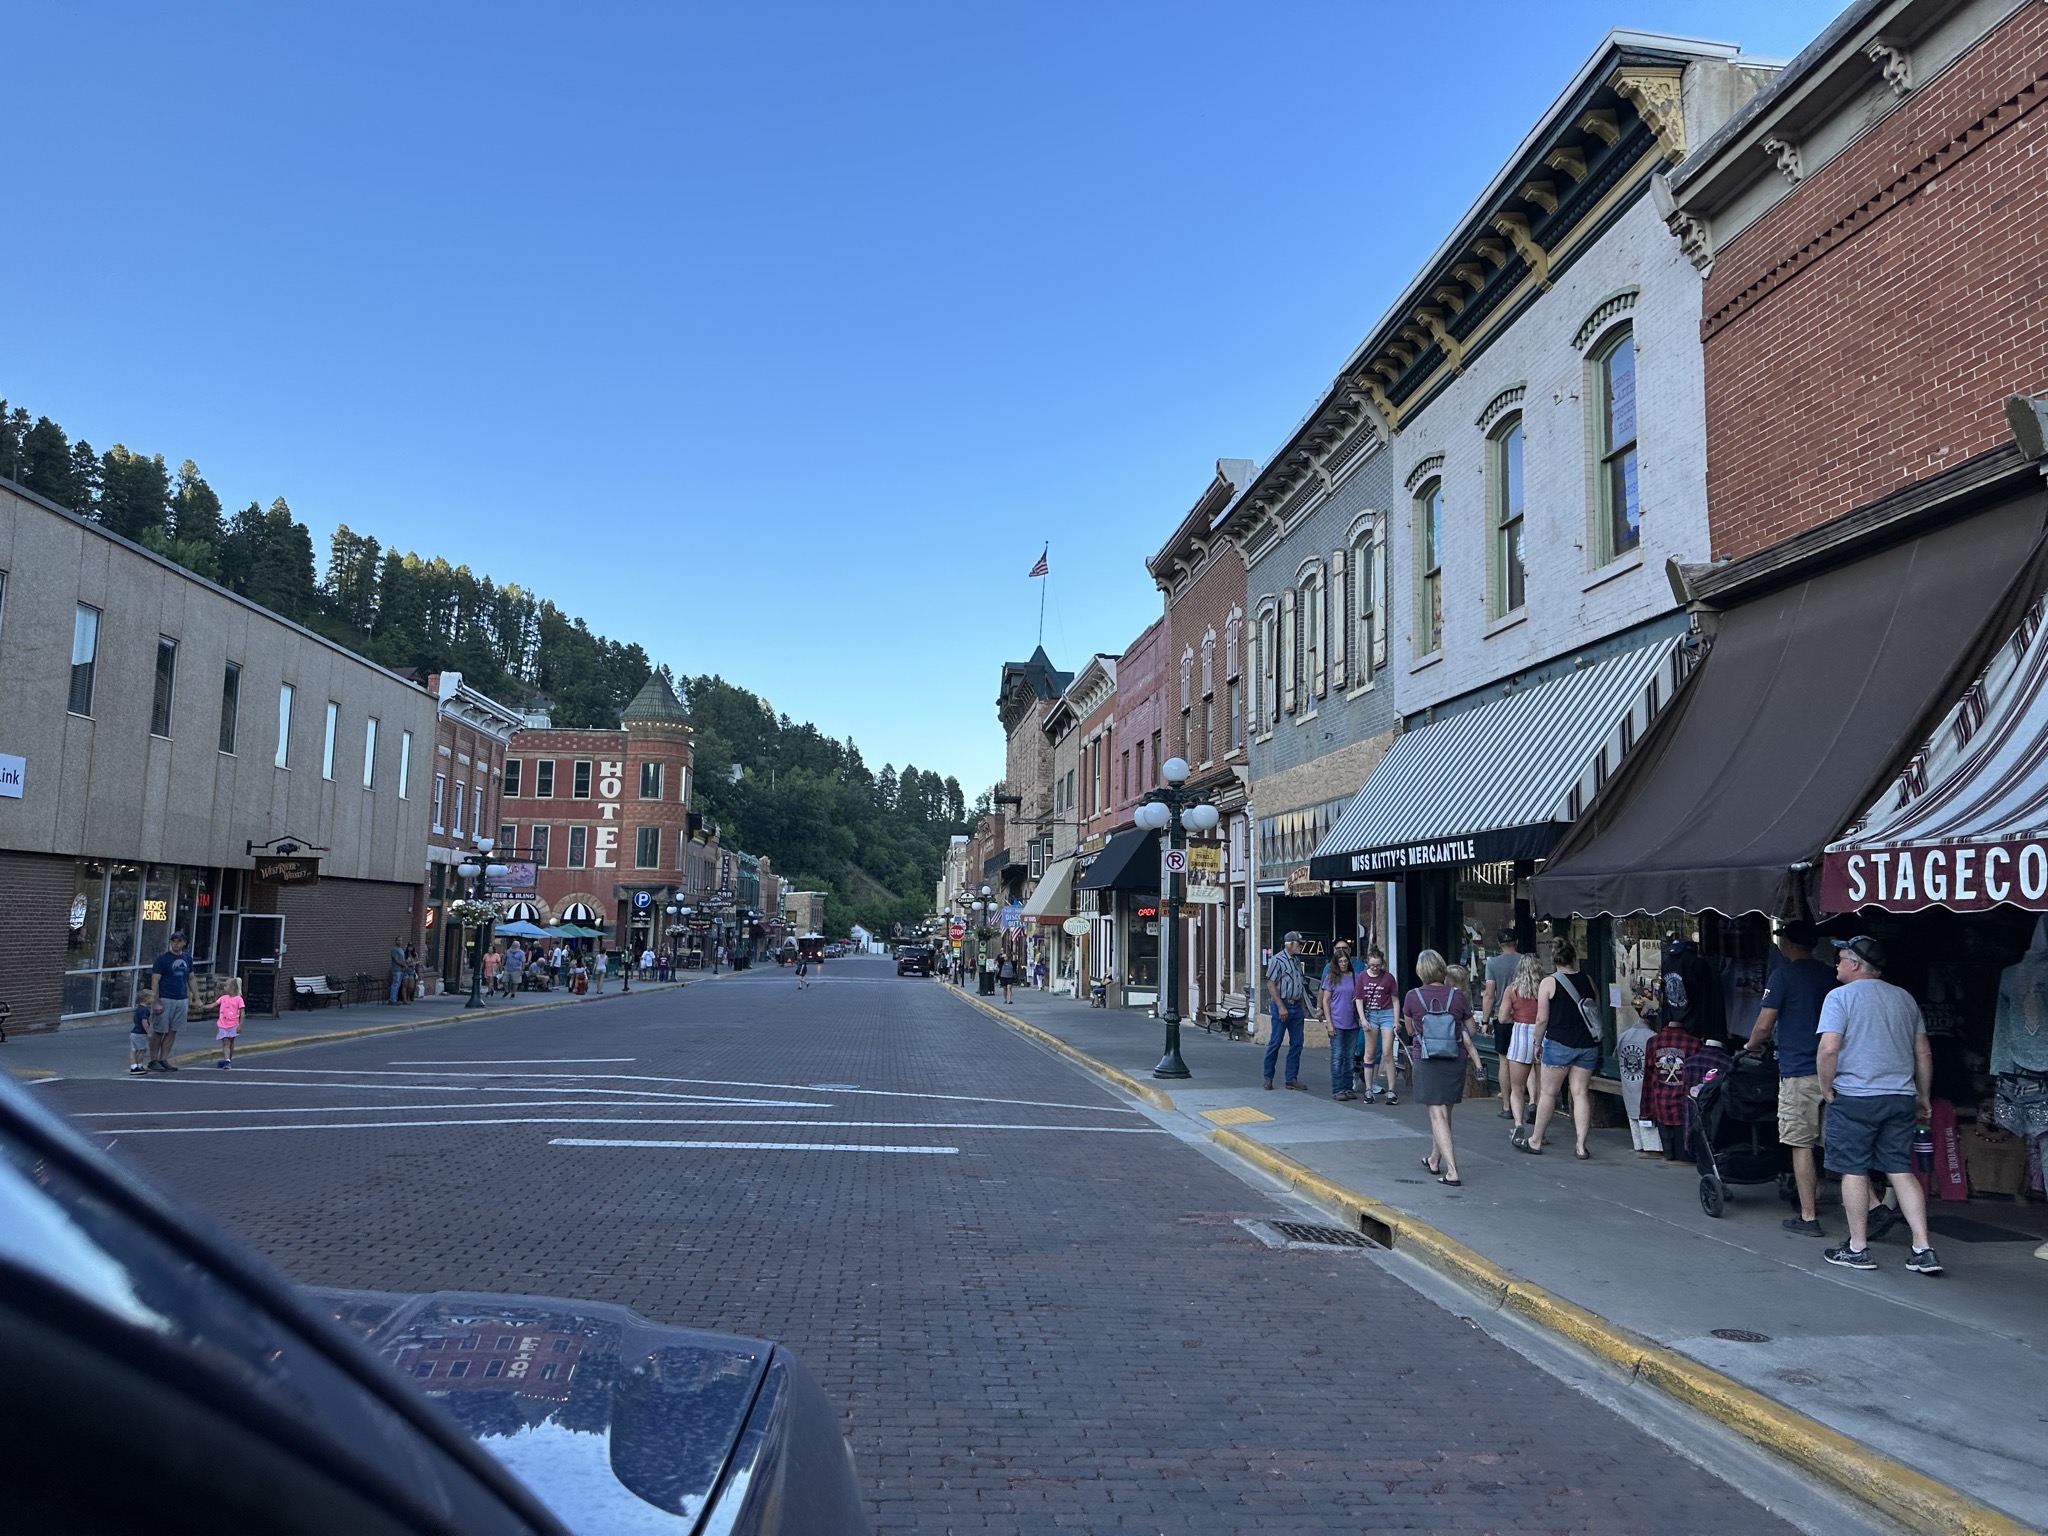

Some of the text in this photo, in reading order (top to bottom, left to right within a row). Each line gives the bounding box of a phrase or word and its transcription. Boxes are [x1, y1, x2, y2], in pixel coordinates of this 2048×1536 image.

[0, 767, 19, 785] ink
[594, 761, 623, 868] HOTEL
[1352, 839, 1475, 872] MISS KITTY'S MERCANTILE
[1847, 843, 2048, 902] STAGECO
[143, 911, 167, 921] ASTINGS
[1137, 908, 1156, 917] OPEN
